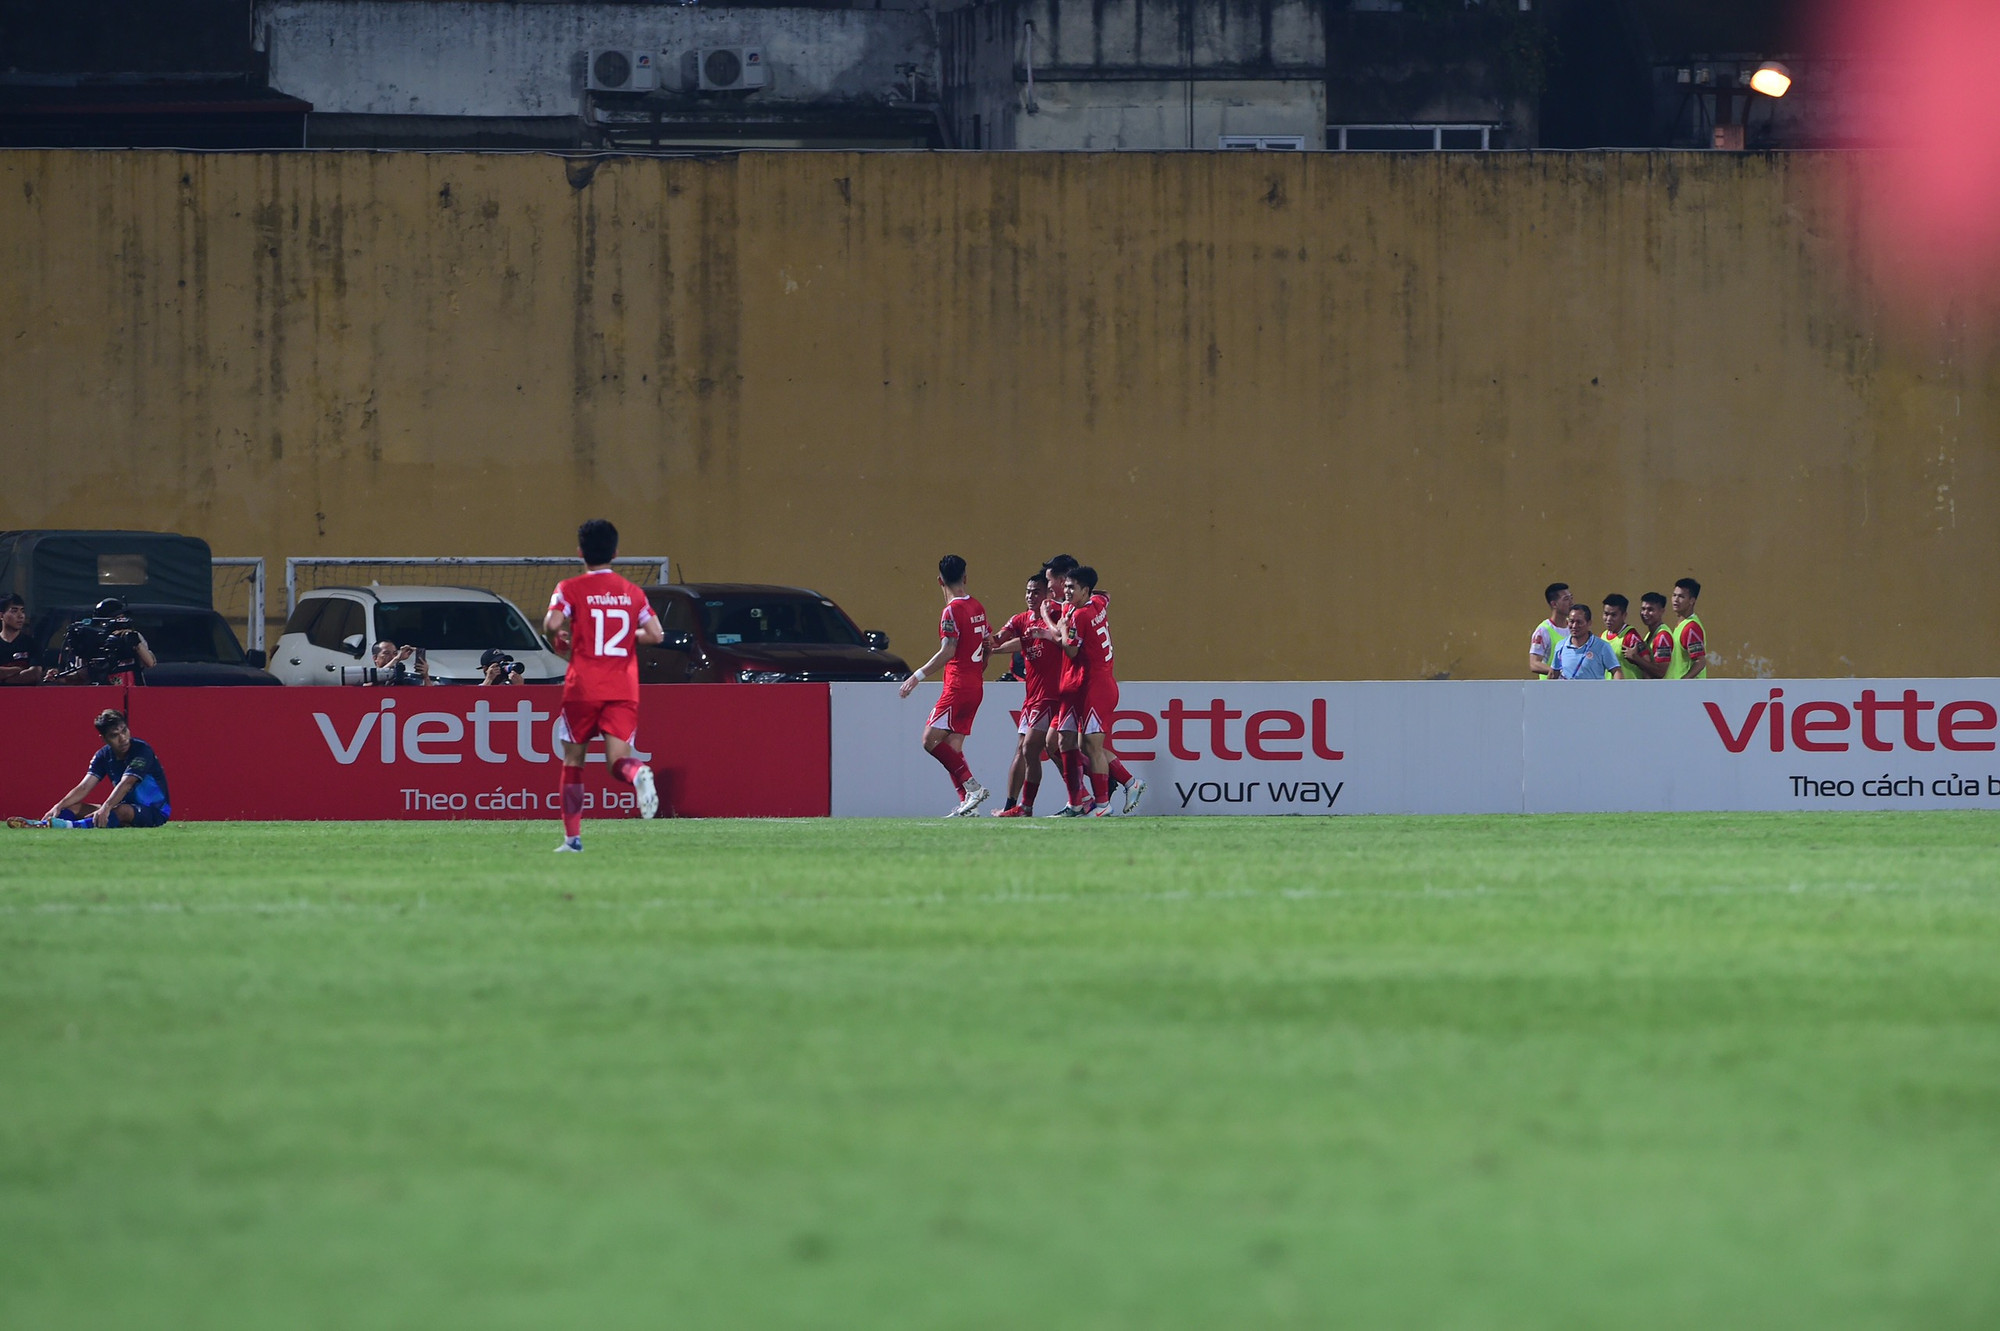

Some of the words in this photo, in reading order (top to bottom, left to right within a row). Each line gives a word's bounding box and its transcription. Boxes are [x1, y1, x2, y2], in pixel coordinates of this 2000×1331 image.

[590, 608, 631, 657] 12
[312, 697, 653, 764] viett
[1009, 698, 1344, 761] ettel
[1702, 687, 1998, 753] viette
[400, 788, 468, 811] Theo
[475, 785, 538, 810] cách
[546, 791, 595, 810] ca
[602, 787, 641, 814] bạ
[1175, 781, 1260, 808] your
[1268, 781, 1344, 808] way
[1789, 775, 1855, 797] Theo
[1862, 773, 1924, 797] cách
[1932, 772, 1980, 797] của
